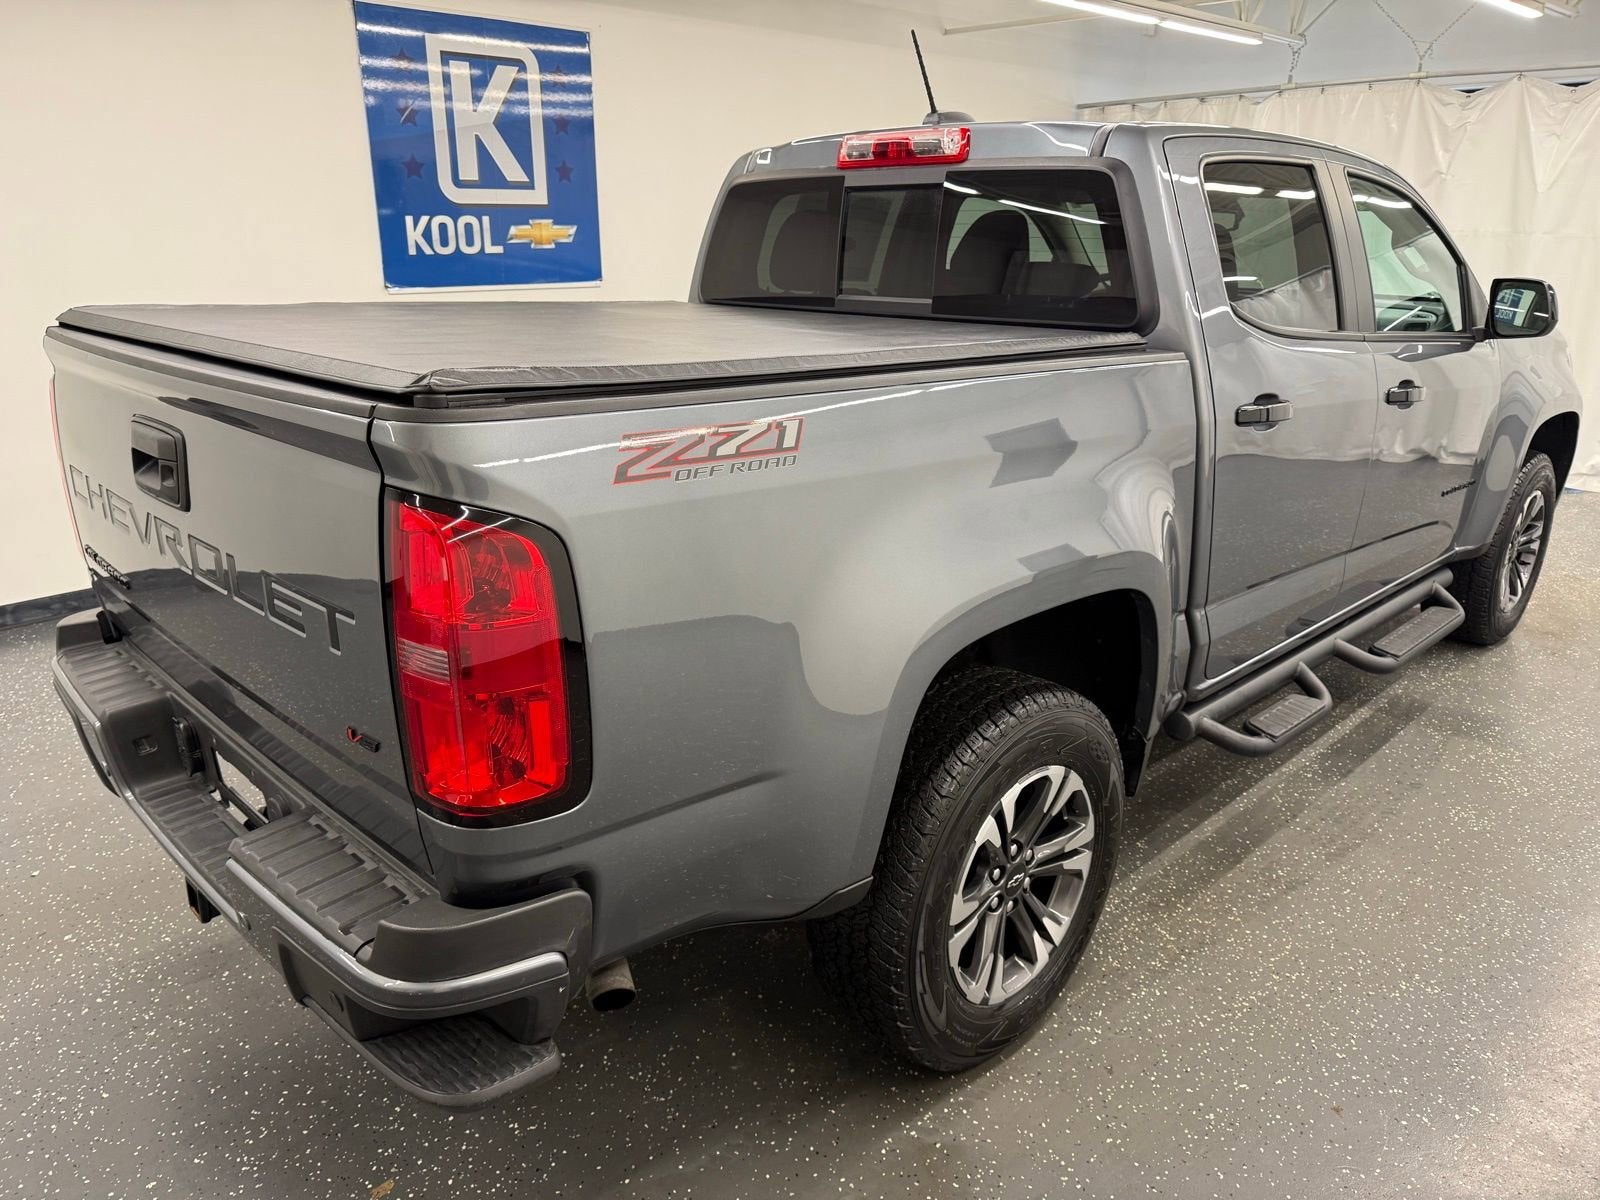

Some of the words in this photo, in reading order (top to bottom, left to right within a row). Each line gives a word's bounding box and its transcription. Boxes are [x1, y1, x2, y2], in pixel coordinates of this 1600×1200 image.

[448, 60, 530, 182] K
[405, 215, 504, 256] KOOL
[613, 417, 804, 484] Z71
[674, 464, 724, 483] OFF
[729, 455, 797, 475] ROAD
[69, 464, 355, 656] CHEVROLET
